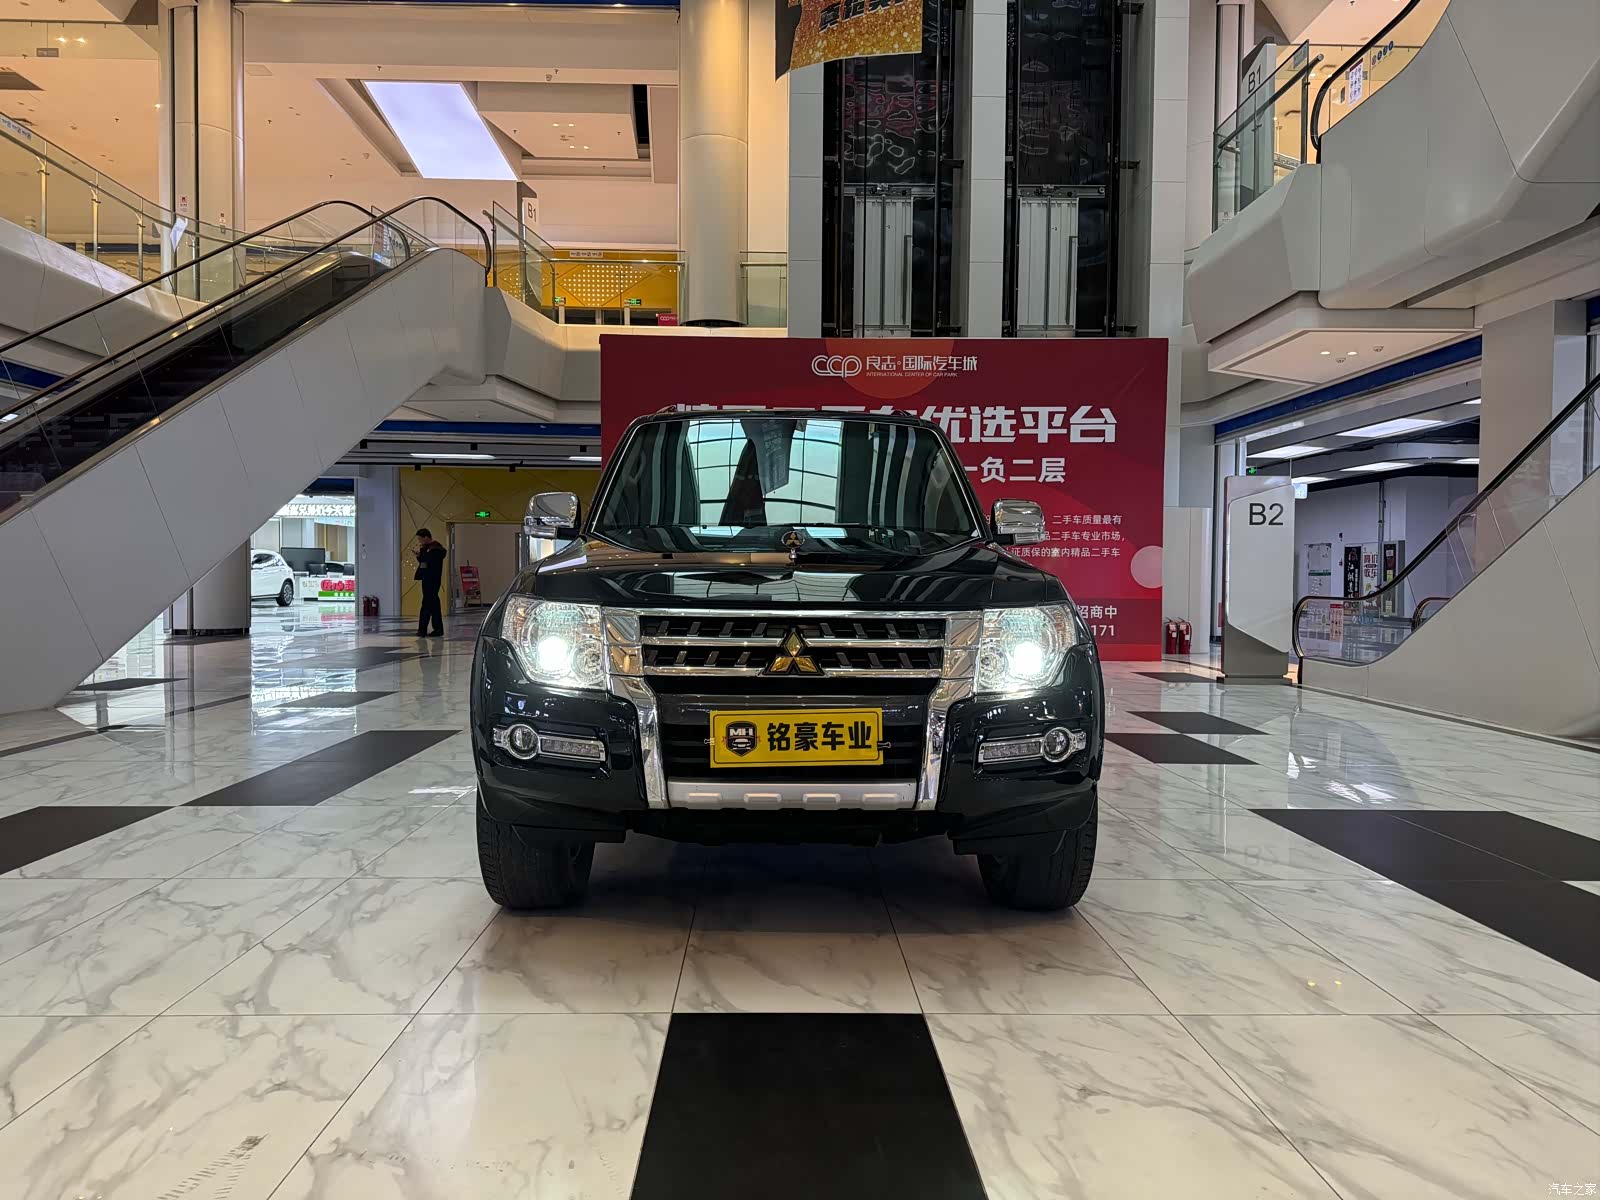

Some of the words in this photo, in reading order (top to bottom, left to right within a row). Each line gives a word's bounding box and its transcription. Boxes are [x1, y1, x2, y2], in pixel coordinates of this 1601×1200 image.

[1248, 65, 1262, 94] B1
[527, 202, 537, 223] B1
[1052, 514, 1122, 525] 二手车质量最有
[1249, 503, 1284, 525] B2
[1077, 605, 1118, 619] 招商中
[1090, 625, 1116, 636] 171
[729, 728, 753, 736] MH
[767, 721, 872, 751] 铭豪车业
